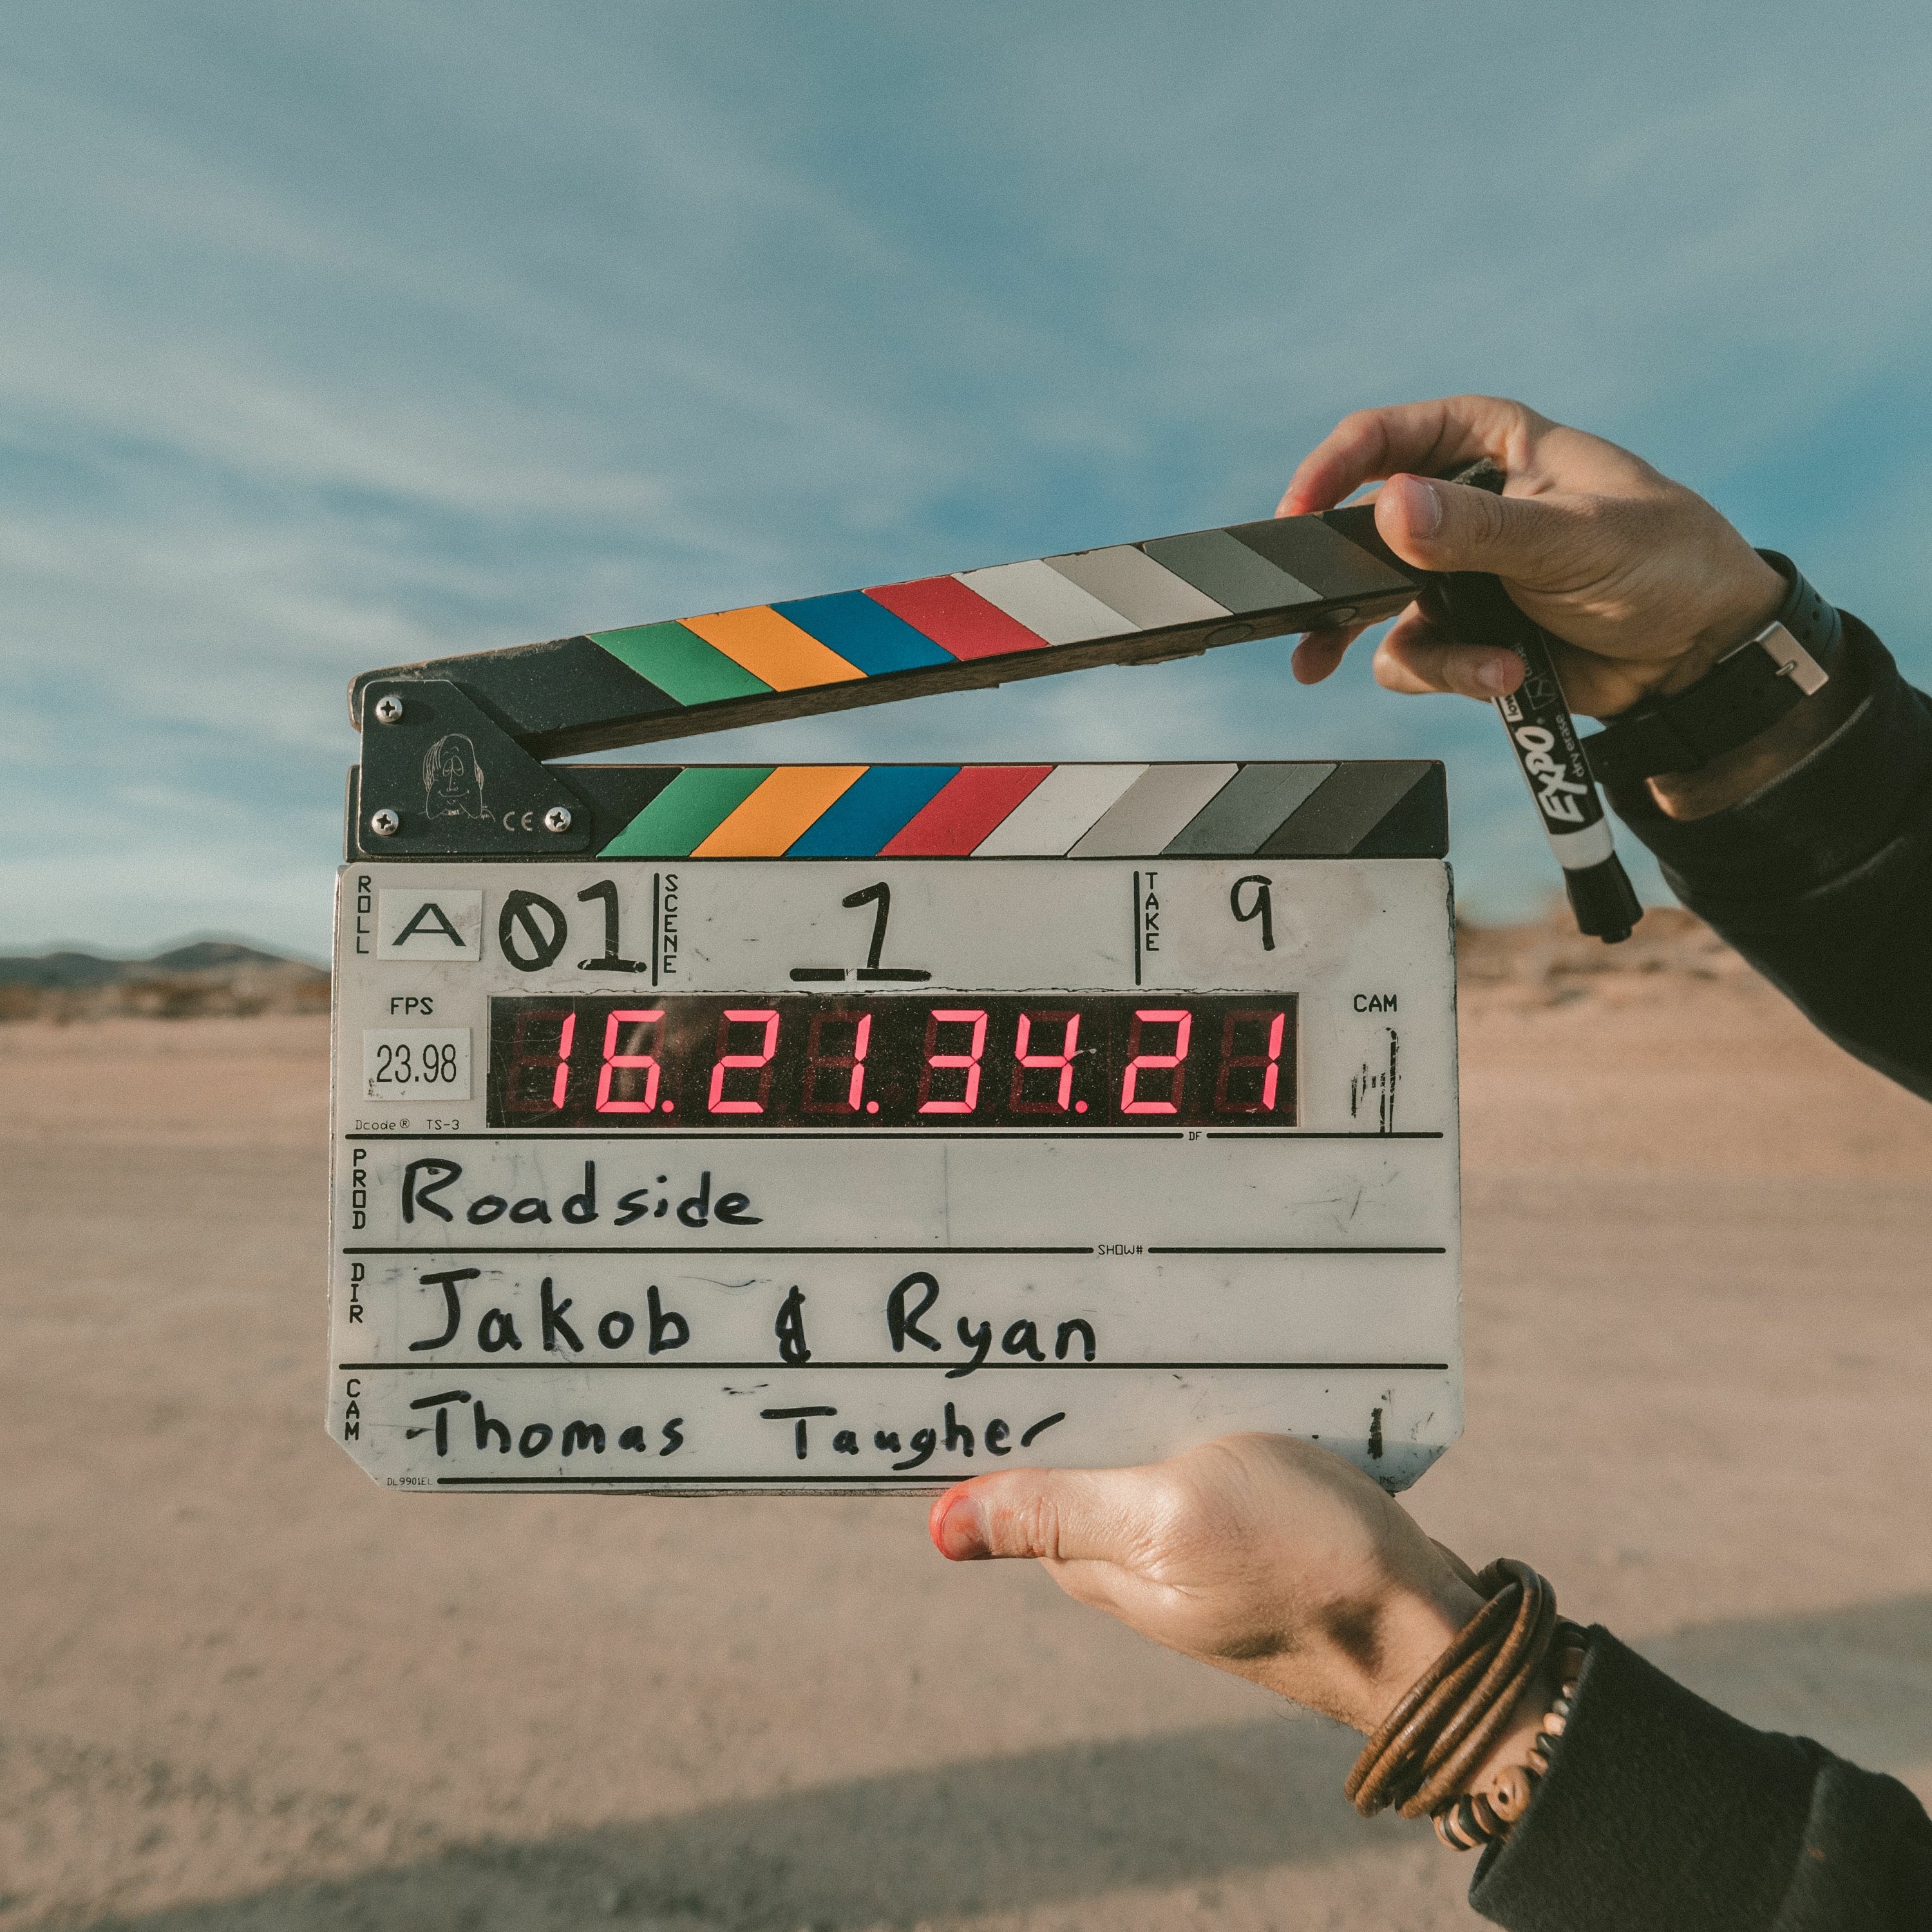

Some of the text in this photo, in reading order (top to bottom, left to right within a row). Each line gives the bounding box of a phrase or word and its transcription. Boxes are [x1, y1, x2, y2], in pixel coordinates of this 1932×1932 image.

[1515, 725, 1588, 823] EXPO
[1556, 714, 1585, 778] dry erase
[355, 875, 372, 954] ROLL
[392, 903, 466, 947] A
[663, 873, 679, 974] SCENE
[789, 881, 933, 982] 1
[1144, 871, 1160, 952] TAKE
[1229, 874, 1276, 952] 9
[390, 996, 434, 1016] FPS
[1353, 993, 1398, 1013] CAM
[375, 1043, 457, 1084] 23.98
[426, 1119, 460, 1131] TS-3
[1188, 1131, 1202, 1141] DF
[351, 1148, 367, 1230] PROD
[401, 1157, 764, 1228] Roadside
[1097, 1244, 1144, 1256] SHOW#
[349, 1262, 365, 1324] DIR
[408, 1267, 690, 1356] Jakob
[886, 1271, 1095, 1379] Ryan
[344, 1378, 361, 1441] CAM
[406, 1389, 1066, 1472] Thomas Taugher
